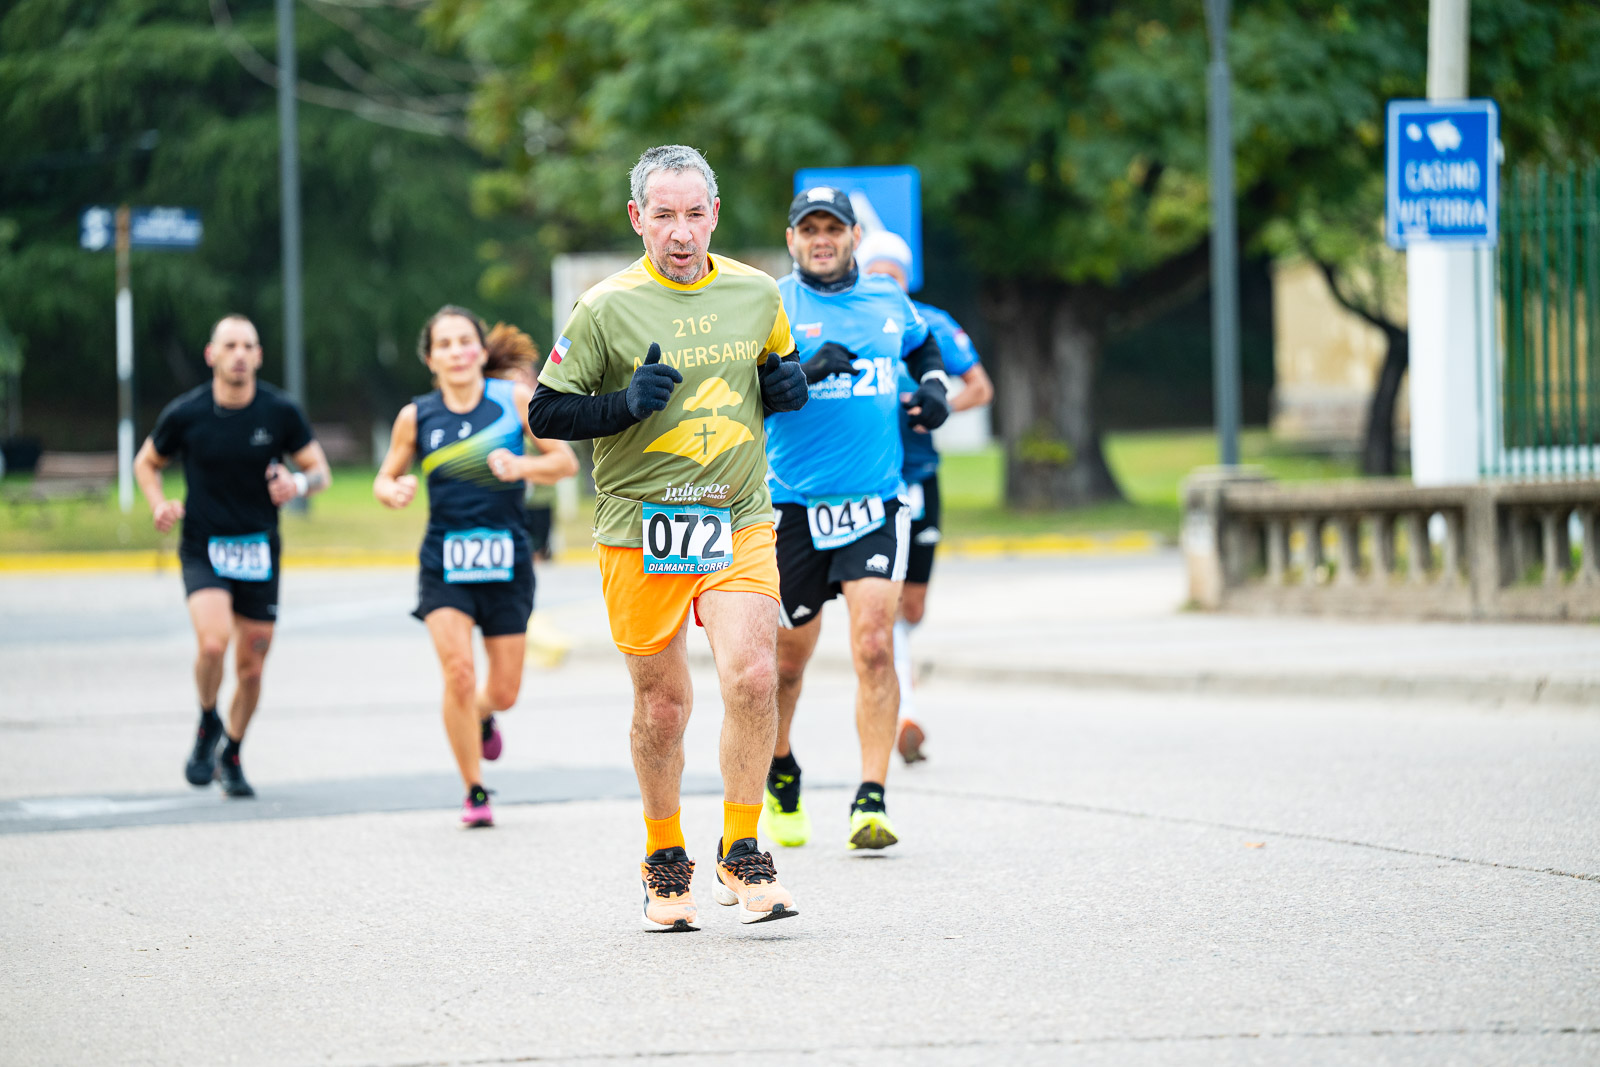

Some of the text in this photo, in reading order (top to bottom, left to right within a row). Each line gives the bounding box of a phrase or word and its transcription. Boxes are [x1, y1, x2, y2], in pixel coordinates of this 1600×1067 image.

[1404, 159, 1481, 193] CASINO
[1399, 197, 1487, 228] VICTORIA
[672, 313, 718, 338] 216°
[816, 496, 873, 536] 041
[647, 511, 725, 560] 072
[450, 537, 505, 568] 020
[648, 560, 730, 573] DIAMANTE CORRE
